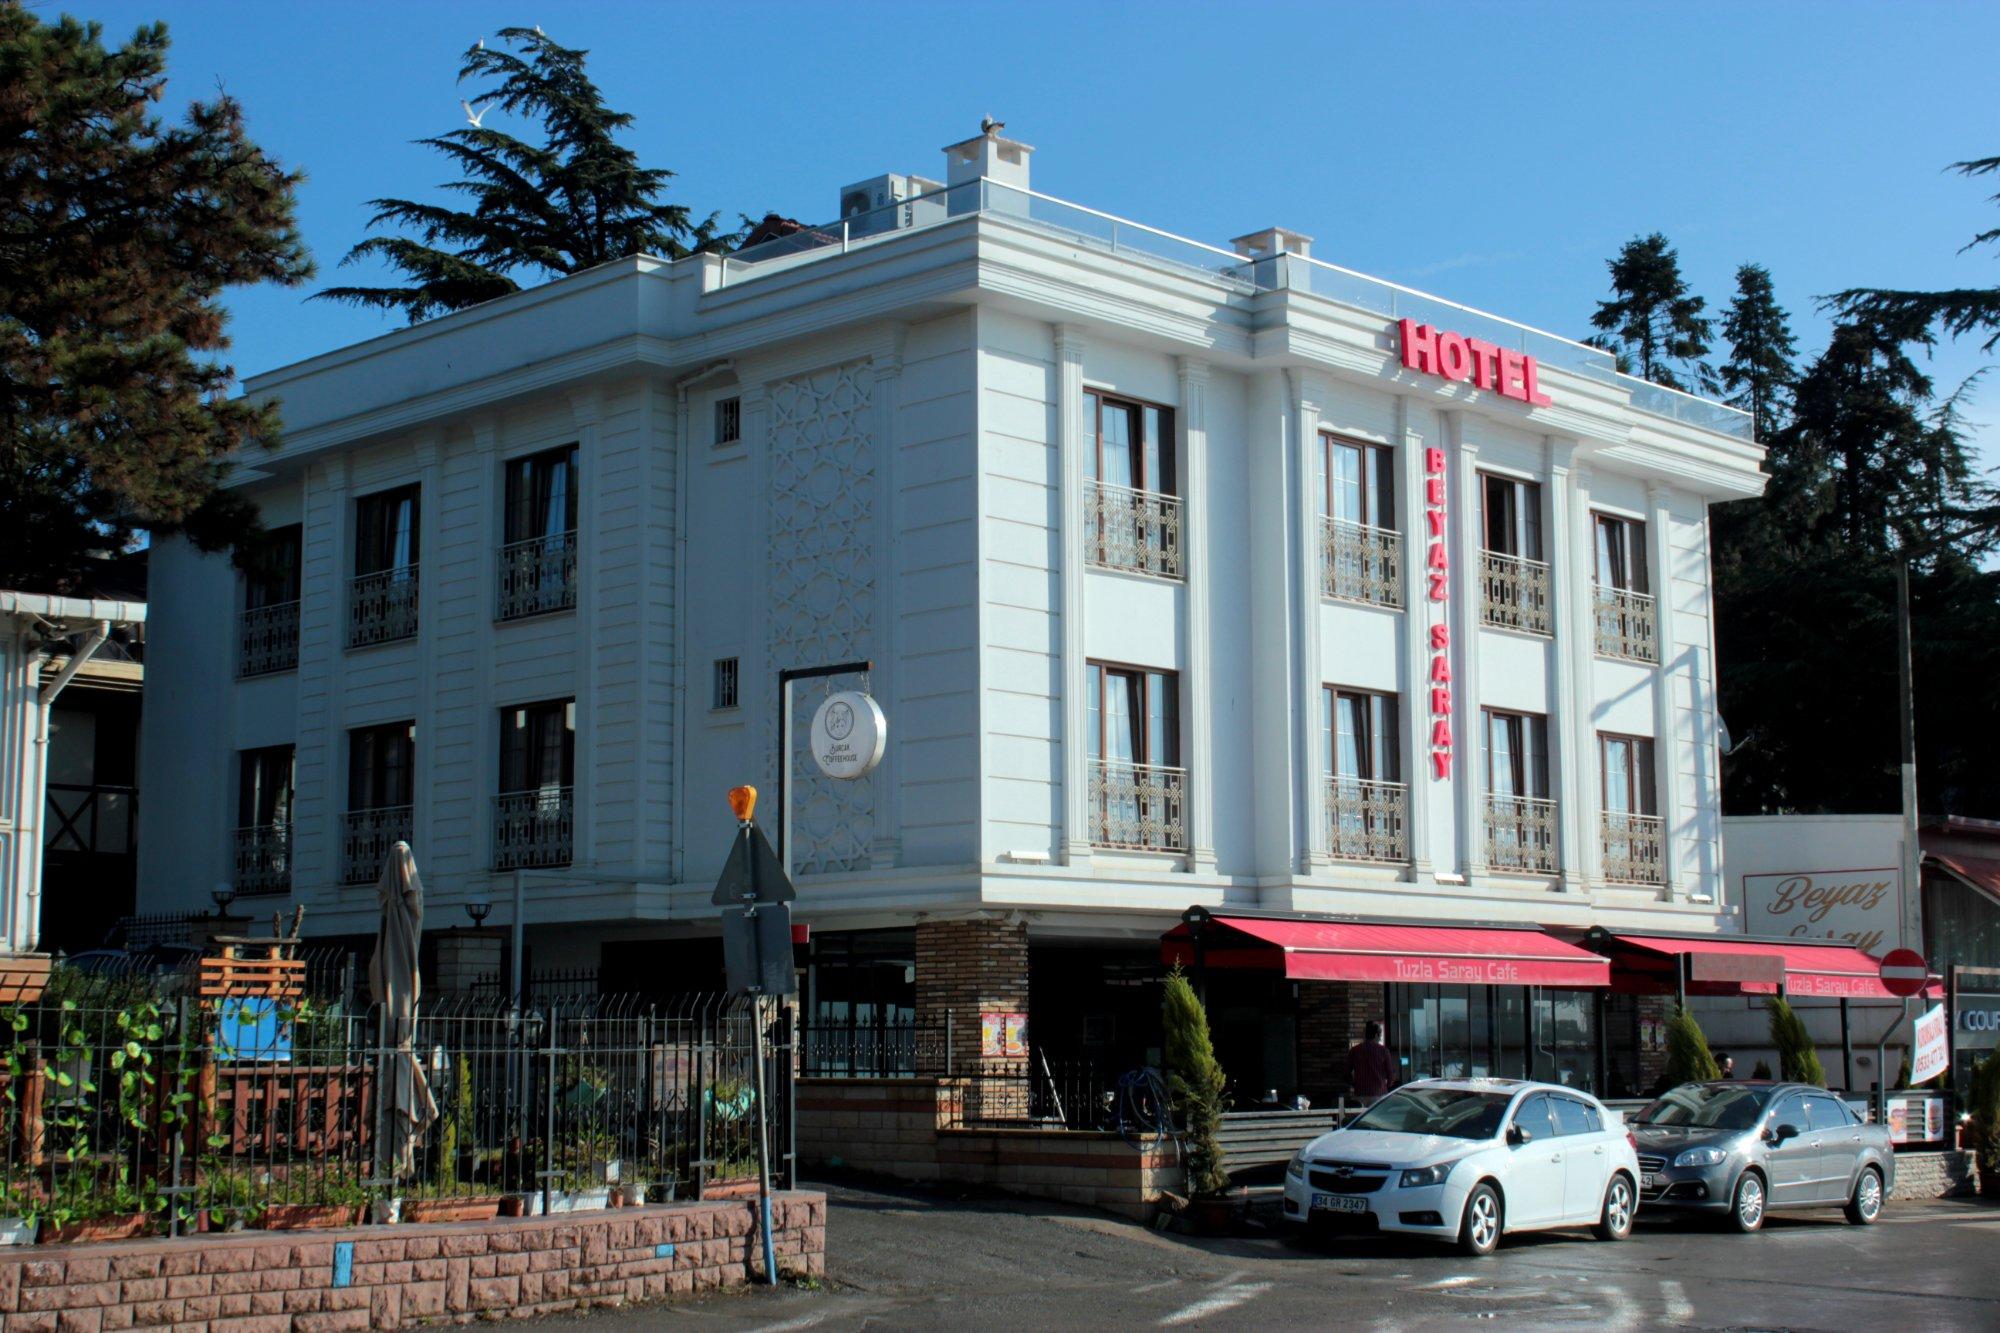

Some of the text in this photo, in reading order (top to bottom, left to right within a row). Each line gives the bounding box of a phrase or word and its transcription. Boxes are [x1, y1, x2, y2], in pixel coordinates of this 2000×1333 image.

[1399, 318, 1552, 408] HOTEL
[1426, 447, 1453, 779] BEYAZ SARAY
[1766, 876, 1891, 923] Beyaz
[1393, 959, 1432, 979] Tuzla
[1438, 960, 1482, 982] Saray
[1785, 975, 1812, 992] Tuzla
[1816, 978, 1848, 995] Saray
